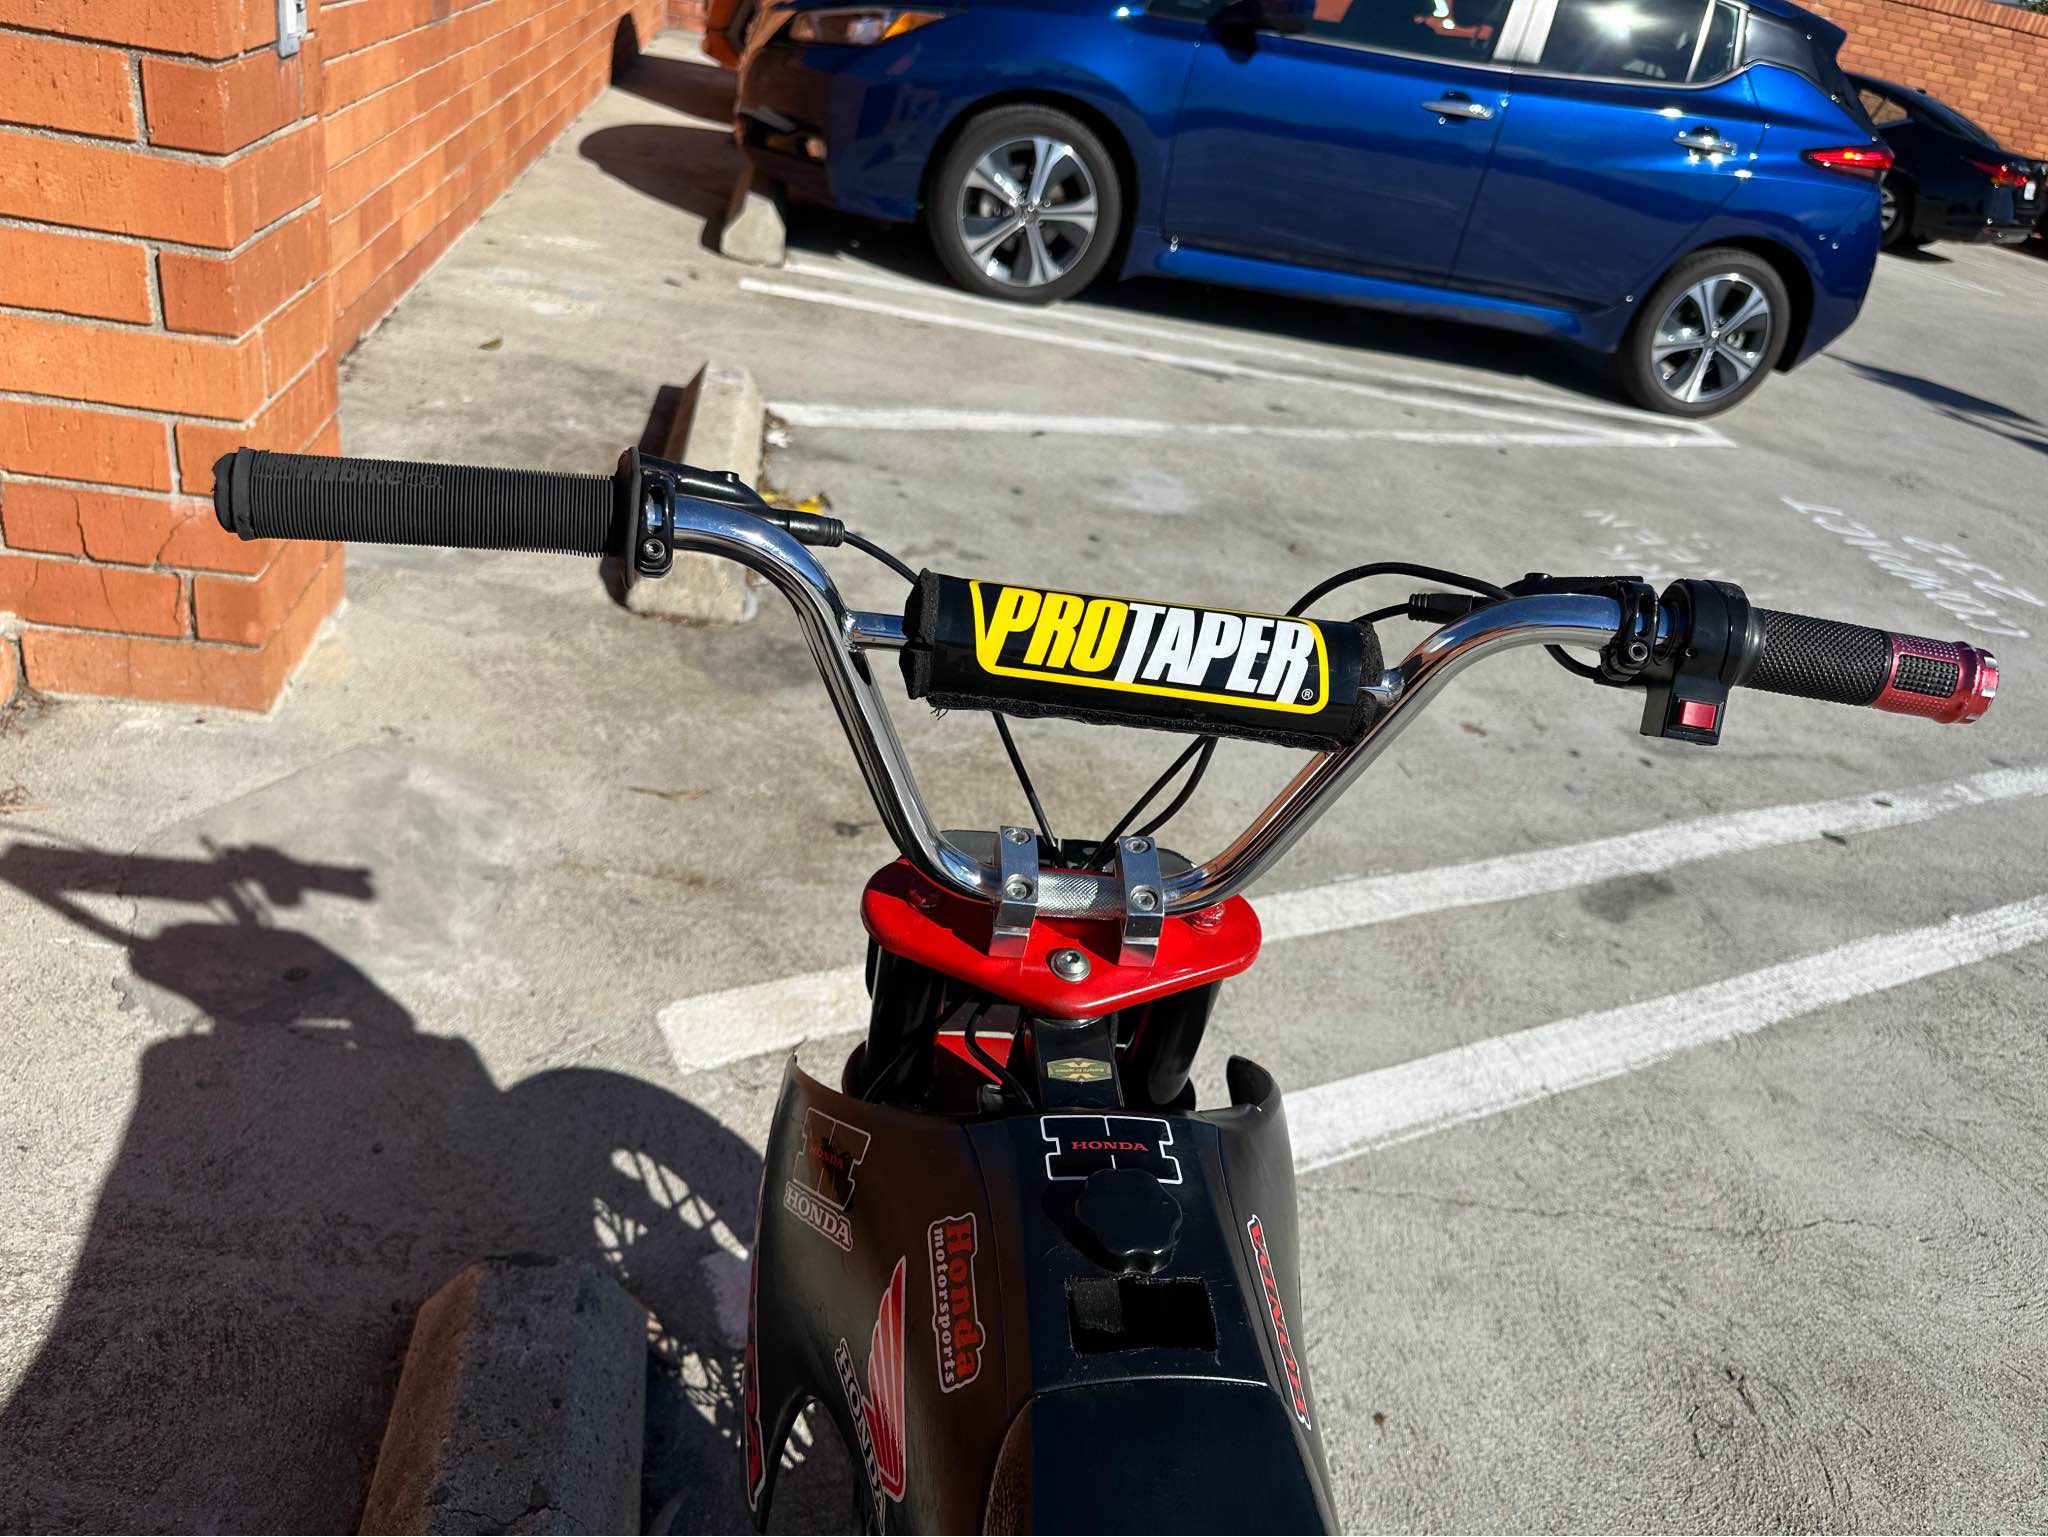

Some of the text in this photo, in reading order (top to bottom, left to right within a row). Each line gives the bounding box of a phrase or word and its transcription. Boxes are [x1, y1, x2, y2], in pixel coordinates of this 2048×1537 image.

[1781, 496, 2031, 638] COMPACT
[786, 1186, 851, 1247] HONDA
[1071, 1140, 1149, 1152] HONDA
[934, 1227, 956, 1384] motorsports
[945, 1221, 981, 1378] Honda
[1250, 1222, 1308, 1418] HONDA
[836, 1344, 885, 1532] HONDA
